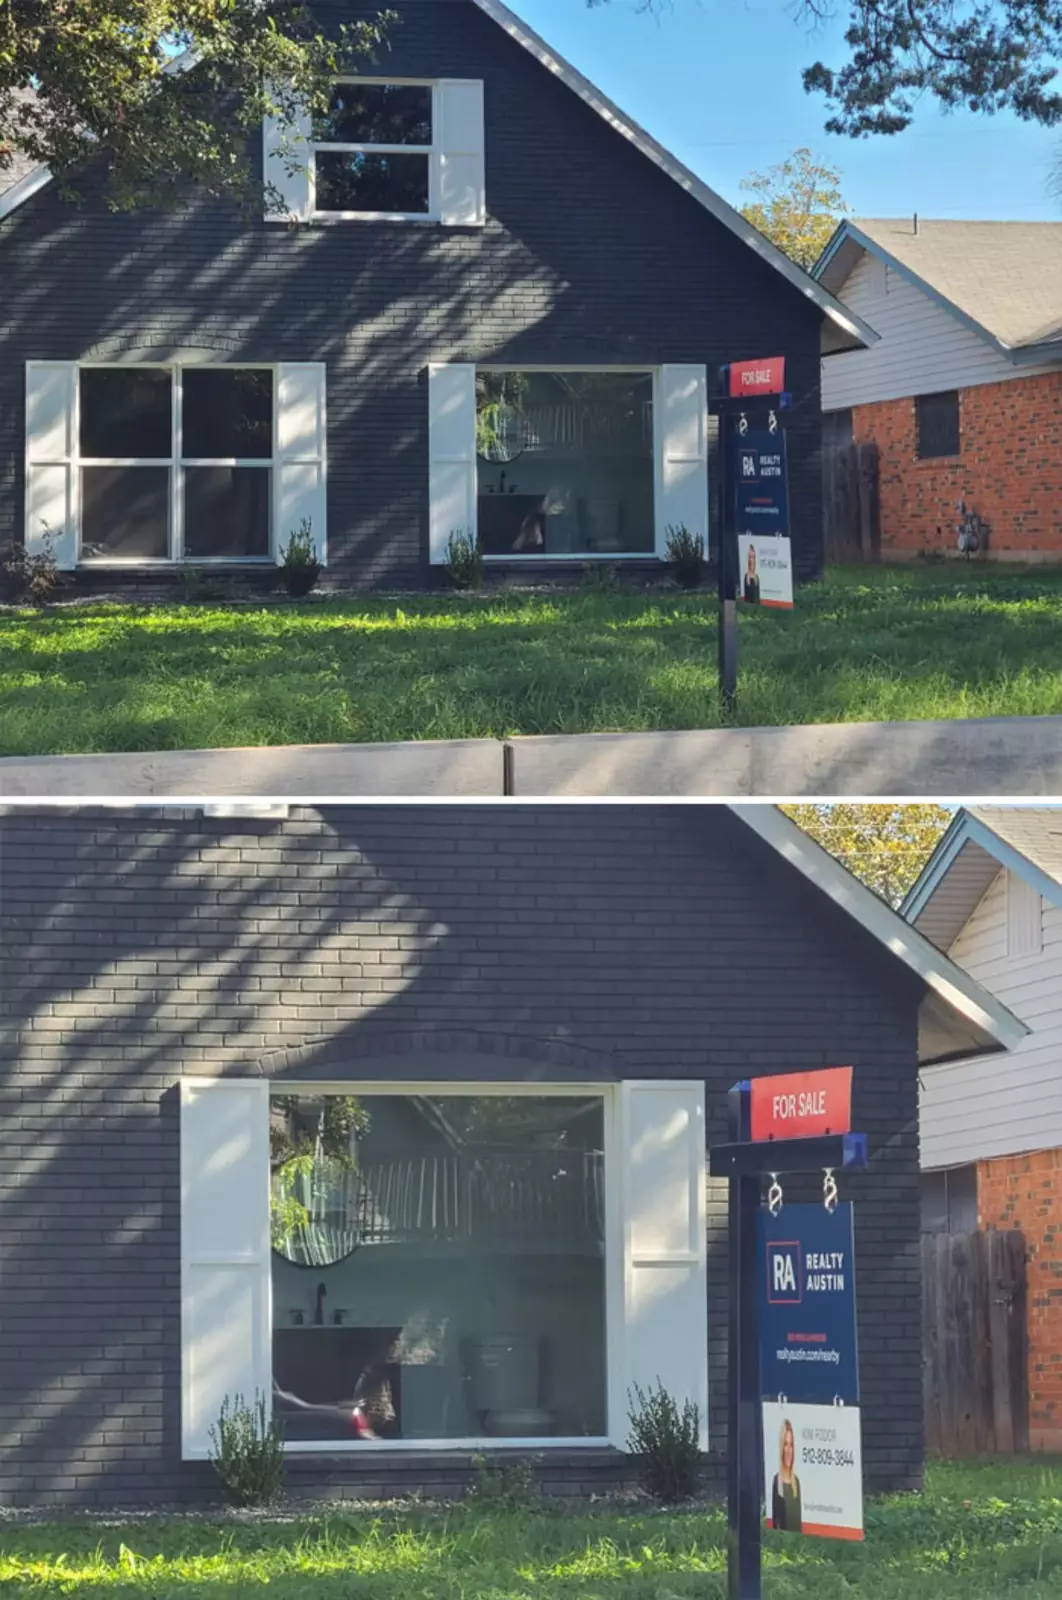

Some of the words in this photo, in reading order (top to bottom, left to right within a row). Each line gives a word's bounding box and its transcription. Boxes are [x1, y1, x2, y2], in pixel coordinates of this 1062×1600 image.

[742, 455, 757, 477] RA
[772, 1094, 796, 1119] FOR
[798, 1090, 826, 1117] SALE
[773, 1253, 796, 1291] RA
[805, 1253, 844, 1270] REALTY
[806, 1274, 845, 1291] AUSTIN
